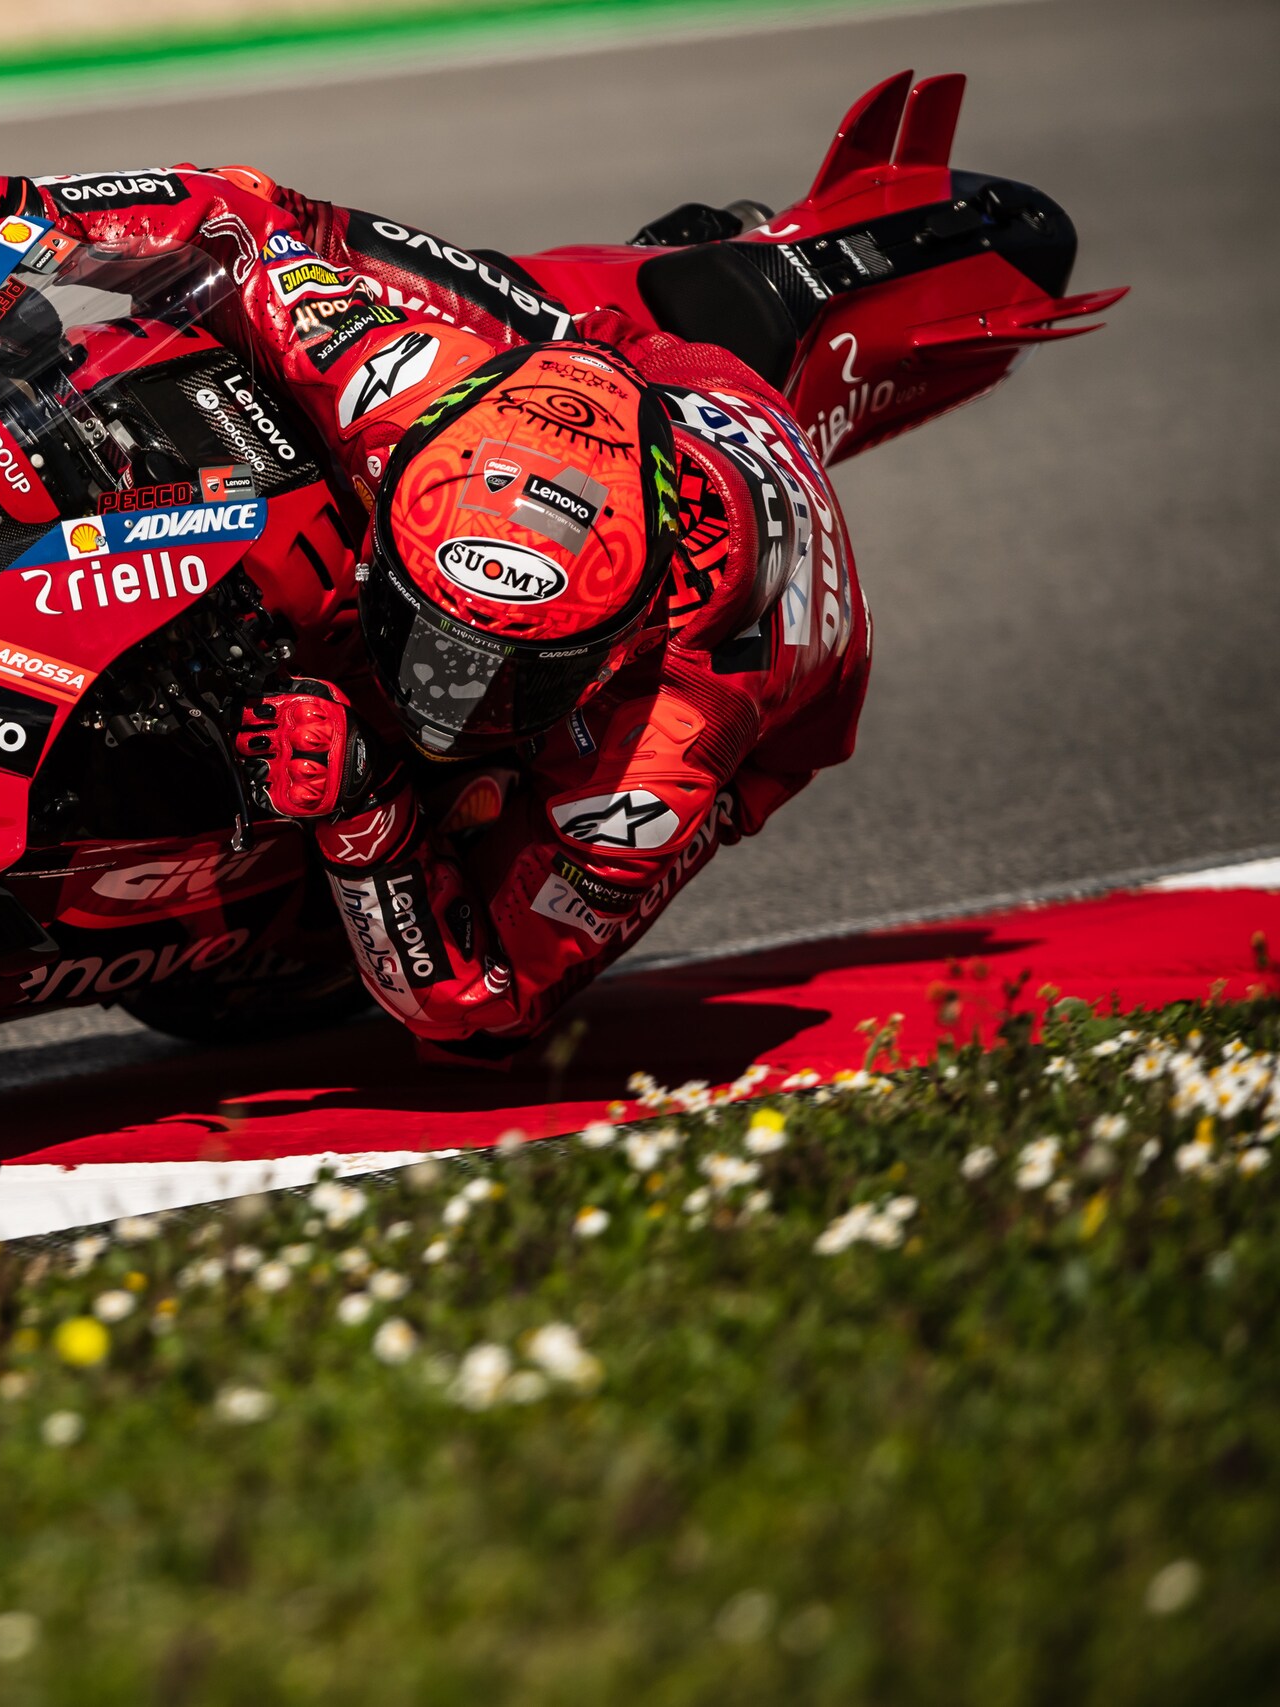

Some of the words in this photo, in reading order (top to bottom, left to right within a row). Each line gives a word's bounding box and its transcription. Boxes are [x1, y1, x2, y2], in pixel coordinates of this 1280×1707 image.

[61, 178, 176, 200] Lenovo
[372, 221, 571, 341] Lenovo
[777, 244, 829, 300] DUCATI
[224, 374, 296, 461] Lenovo
[213, 409, 266, 473] motorola
[225, 479, 250, 487] Lenovo
[488, 461, 518, 474] DUCATI
[97, 482, 193, 515] PECCO
[529, 479, 589, 519] Lenovo
[124, 503, 258, 543] ADVANCE
[545, 510, 568, 525] FACTORY
[568, 522, 581, 534] TEAM
[67, 551, 209, 612] riello
[449, 541, 554, 599] SUOMY
[387, 570, 421, 611] CARRERA
[539, 647, 589, 659] CARRERA
[387, 874, 434, 978] Lenovo
